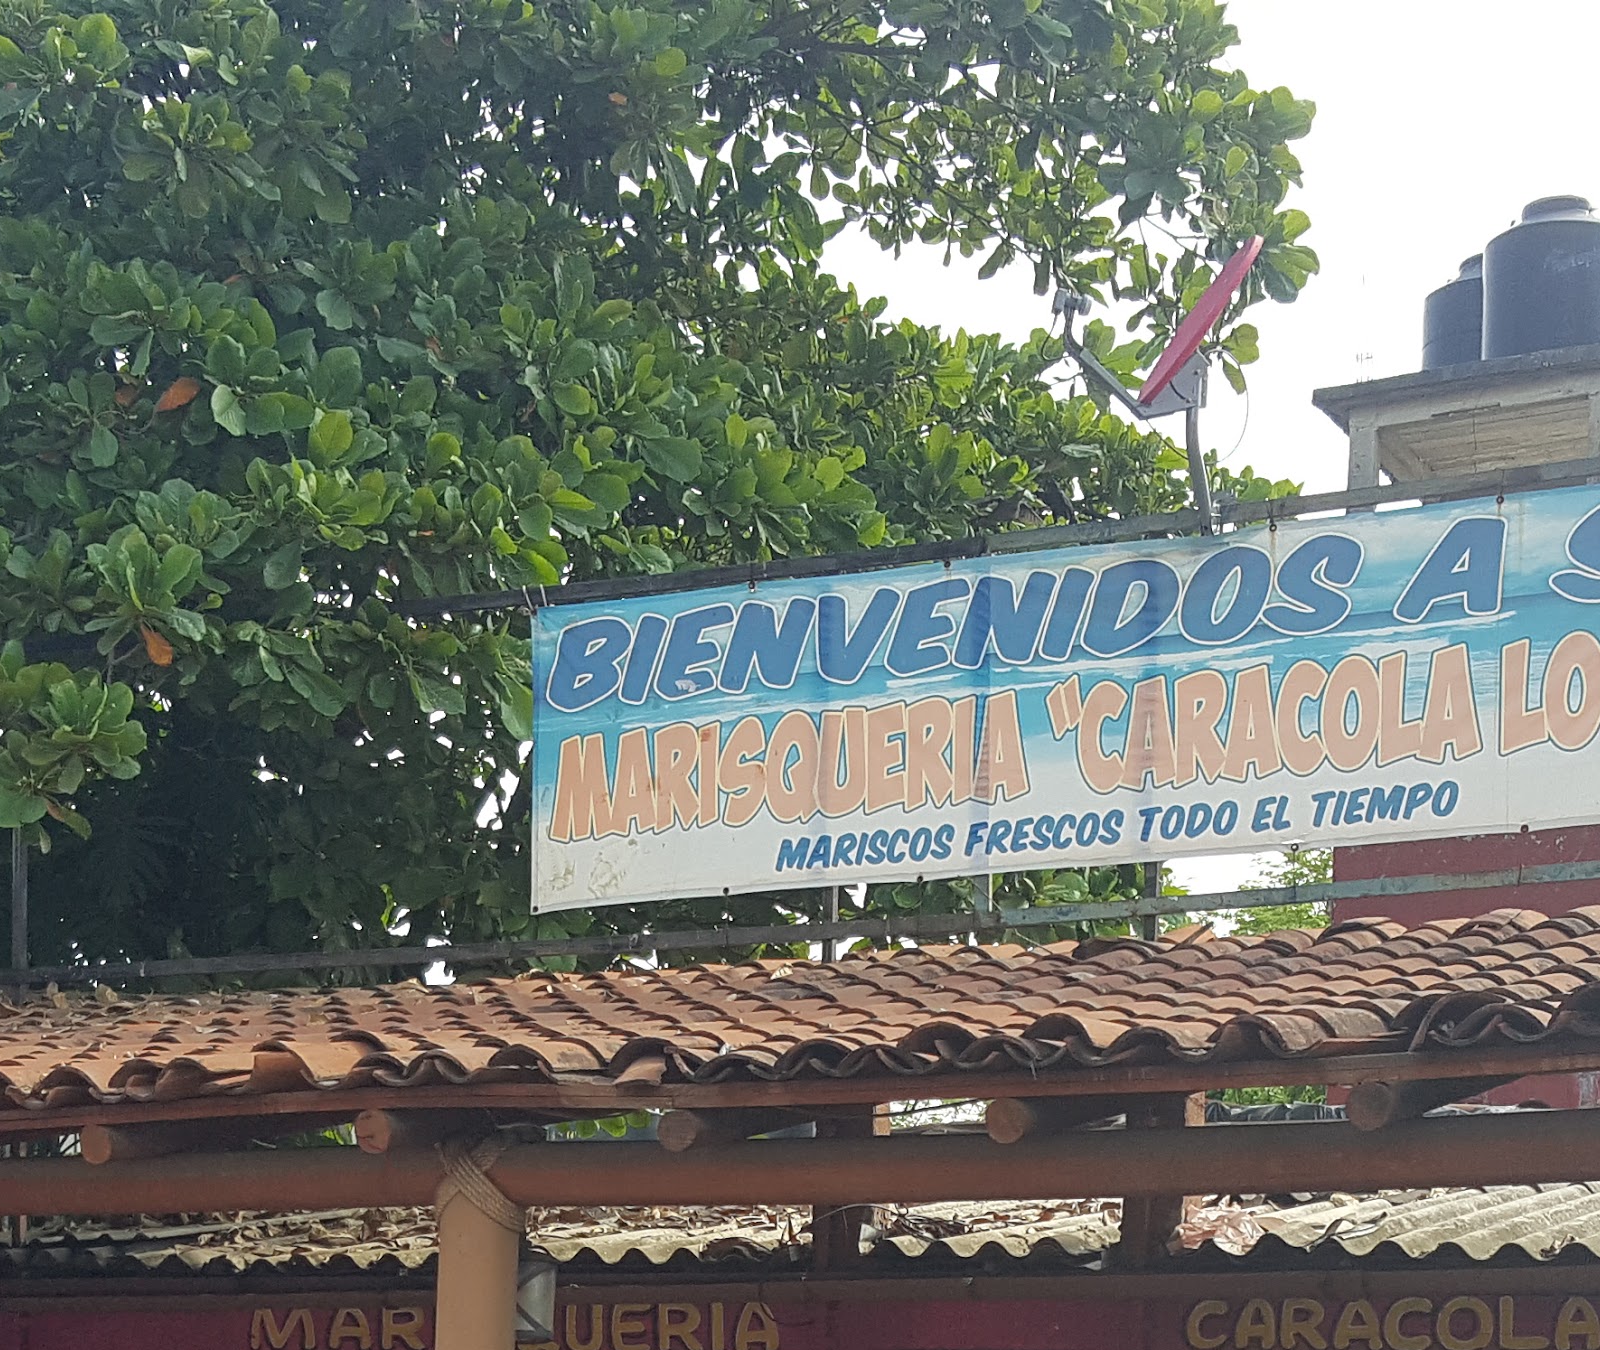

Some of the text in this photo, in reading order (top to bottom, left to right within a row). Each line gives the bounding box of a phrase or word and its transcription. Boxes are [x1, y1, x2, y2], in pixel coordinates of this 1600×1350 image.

[546, 532, 1365, 713] BIENVENIDOS
[1393, 515, 1508, 624] A
[549, 687, 1032, 843] MARISQUERIA
[775, 779, 1460, 873] MARISCOS FRESCOS TODO EL TIEMPO
